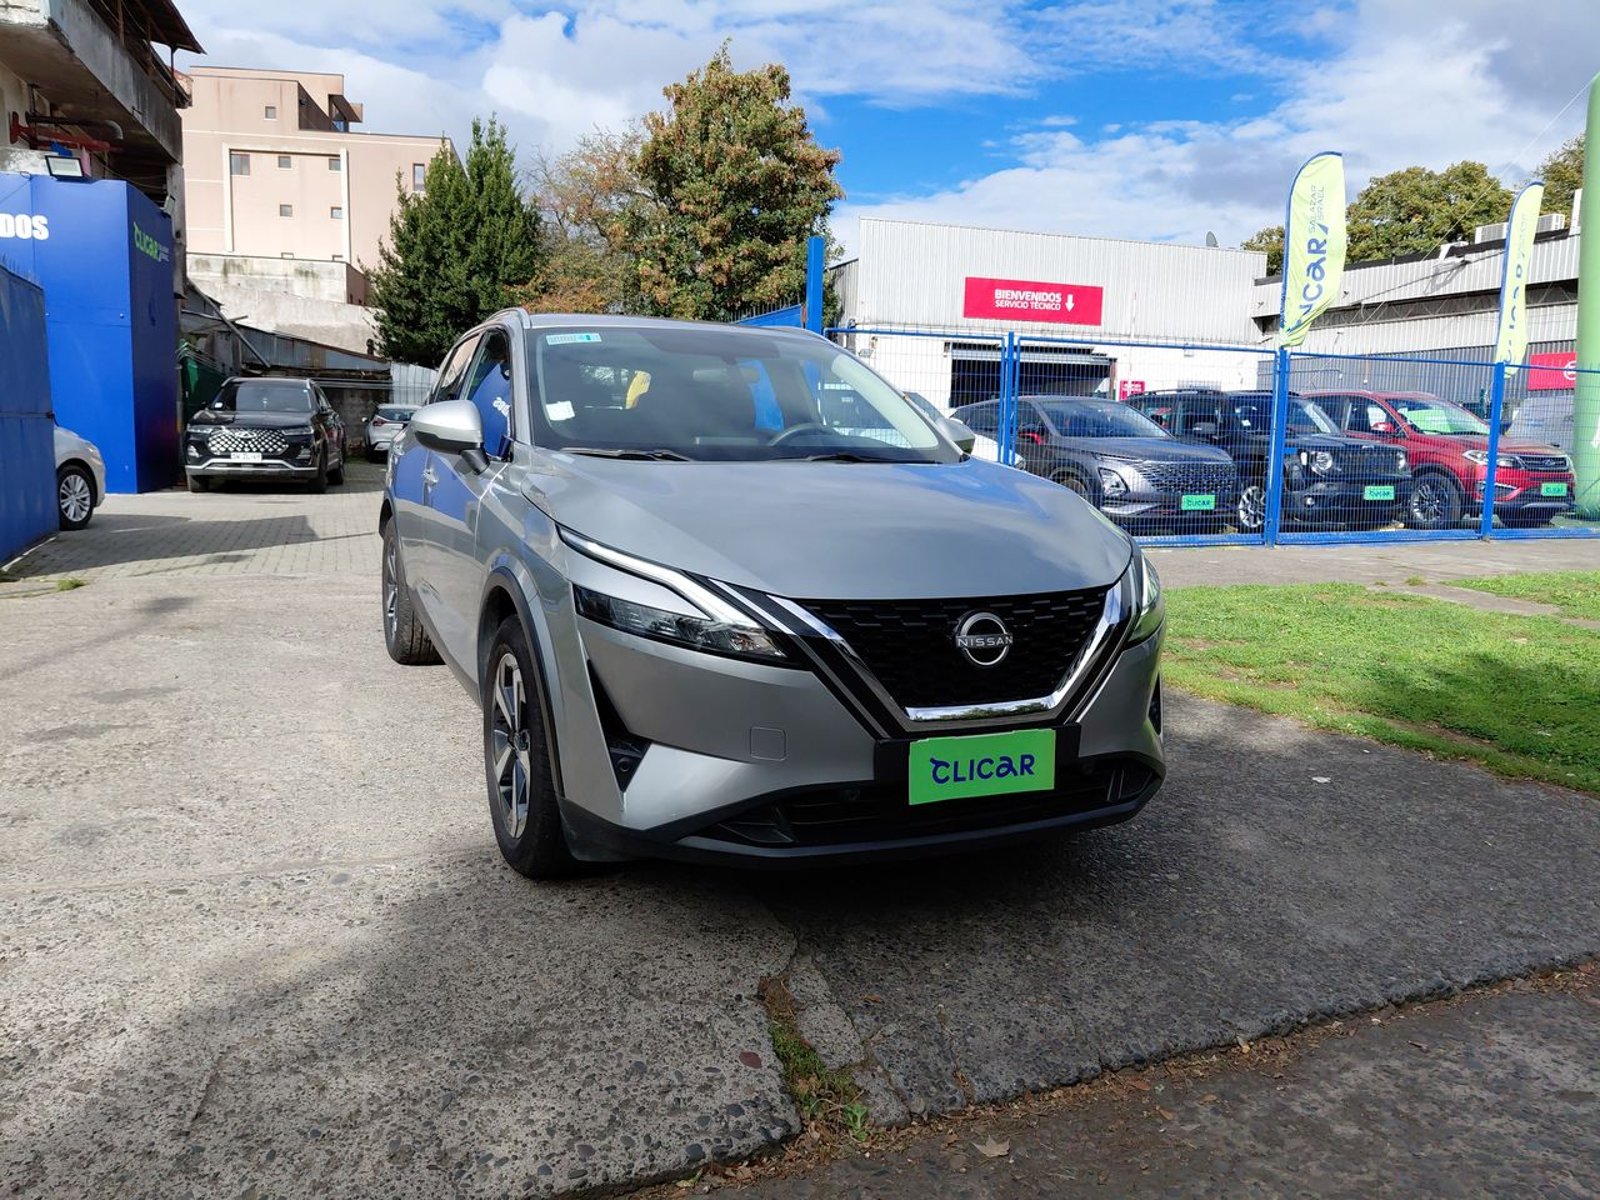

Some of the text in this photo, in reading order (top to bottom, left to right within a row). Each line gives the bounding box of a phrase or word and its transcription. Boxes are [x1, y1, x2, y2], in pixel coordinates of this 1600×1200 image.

[995, 289, 1062, 303] BIENVENIDOS
[995, 299, 1029, 309] SERVICIO
[957, 636, 1013, 648] NISSAN
